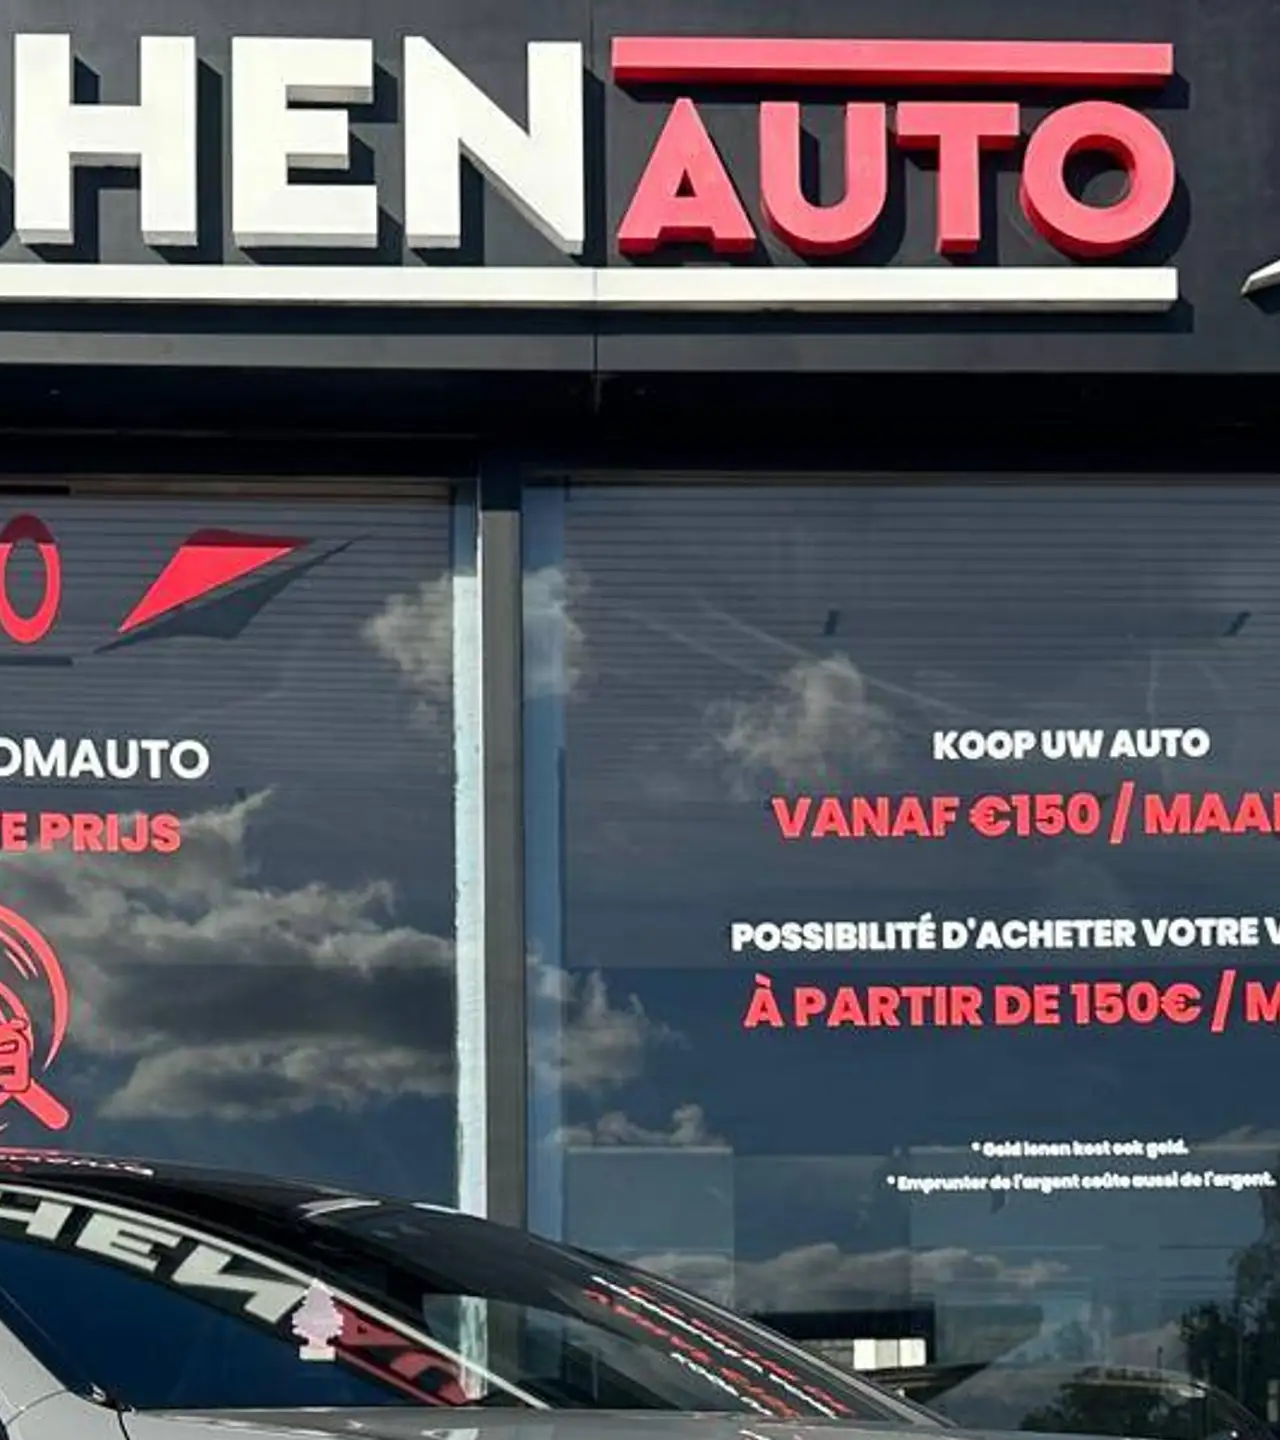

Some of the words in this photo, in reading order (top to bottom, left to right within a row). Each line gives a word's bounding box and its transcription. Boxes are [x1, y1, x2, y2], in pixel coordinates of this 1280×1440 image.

[617, 97, 1175, 259] AUTO
[932, 729, 1037, 761] KOOP
[1041, 728, 1104, 760] UW
[1109, 727, 1211, 759] AUTO
[38, 811, 182, 854] PRIJS
[773, 795, 959, 838] VANAF
[968, 792, 1101, 838] €150
[731, 912, 937, 952] POSSIBILITÉ
[942, 916, 1136, 950] D'ACHETER
[1141, 916, 1260, 948] VOTRE
[743, 974, 783, 1029] À
[793, 984, 984, 1028] PARTIR
[993, 983, 1062, 1026] DE
[1070, 981, 1201, 1025] 150€
